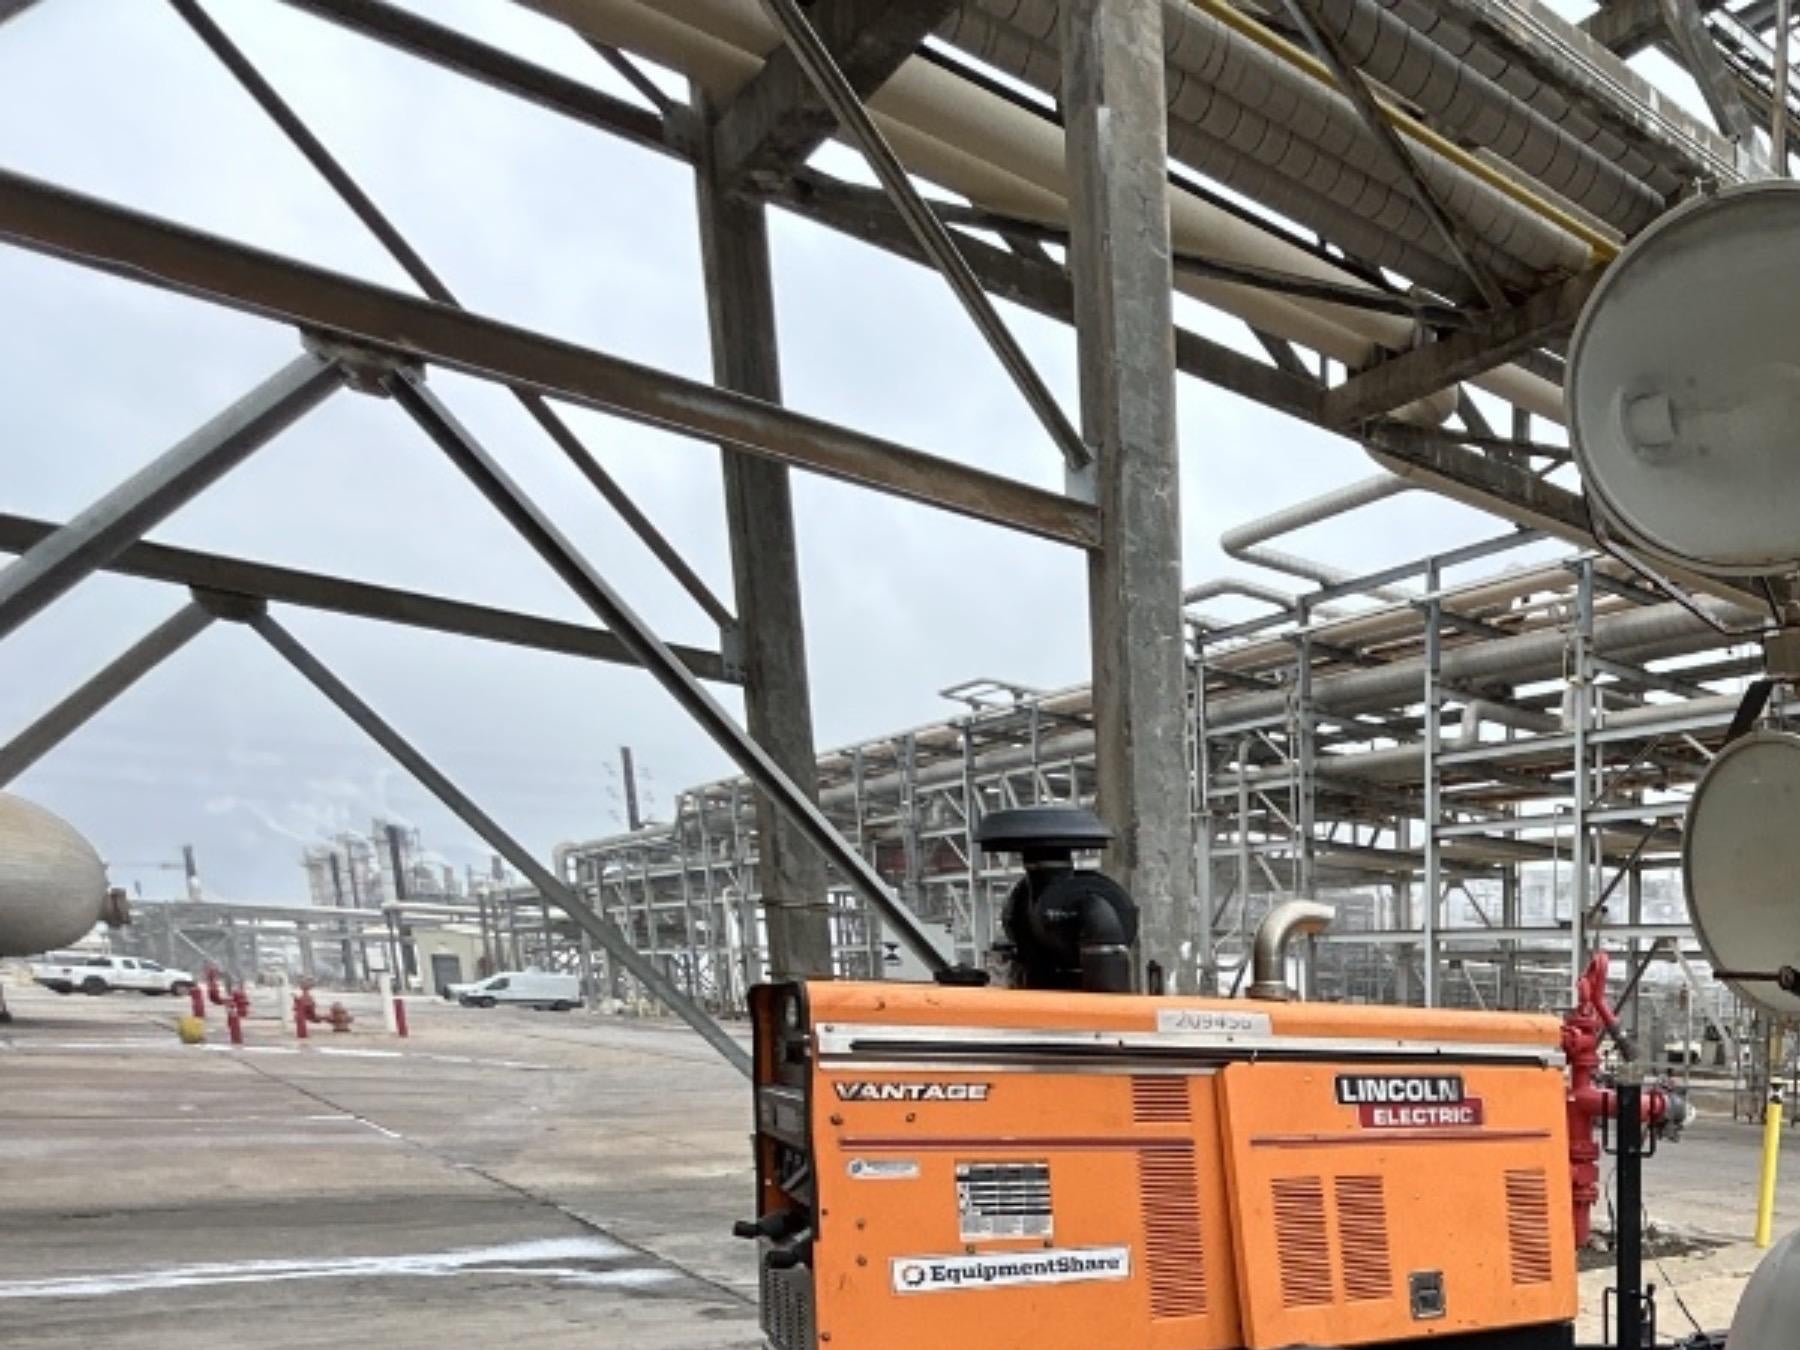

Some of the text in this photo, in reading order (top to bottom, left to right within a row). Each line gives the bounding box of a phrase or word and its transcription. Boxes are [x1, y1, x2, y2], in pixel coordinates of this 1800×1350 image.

[835, 1082, 990, 1101] VANTAGE
[1340, 1078, 1459, 1102] LINCOLN
[1373, 1106, 1474, 1126] ELECTRIC
[929, 1256, 1121, 1284] EquipmentShare
